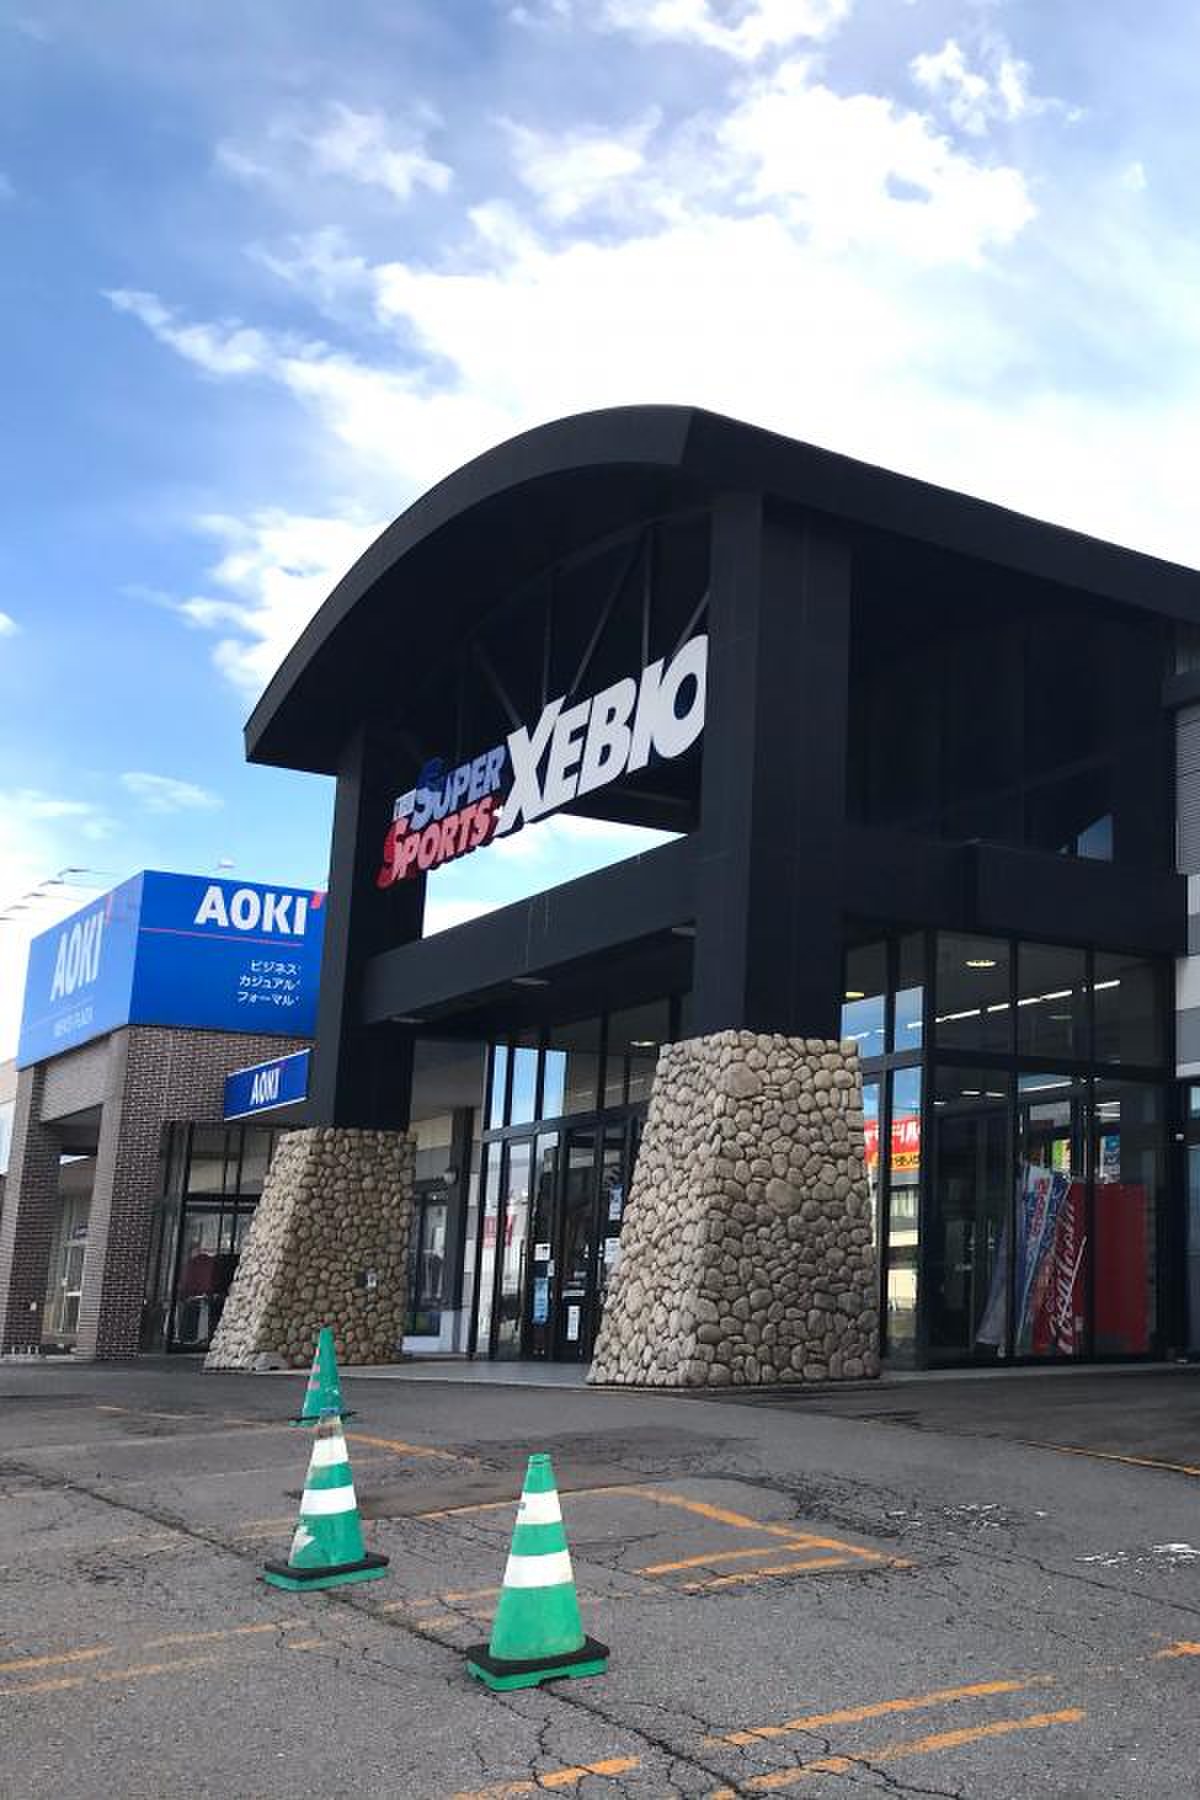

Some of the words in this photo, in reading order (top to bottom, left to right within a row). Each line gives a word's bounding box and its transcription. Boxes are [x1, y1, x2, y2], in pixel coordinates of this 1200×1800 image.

[494, 634, 708, 837] XEBIO
[409, 744, 506, 831] SUPER
[377, 796, 494, 888] SPORTS
[193, 885, 308, 935] AOKI
[50, 911, 105, 1001] AOKI
[251, 960, 298, 975] ビジネス
[237, 991, 296, 1006] フォーマル
[239, 976, 297, 990] カジュアル
[250, 1067, 280, 1106] AOKI
